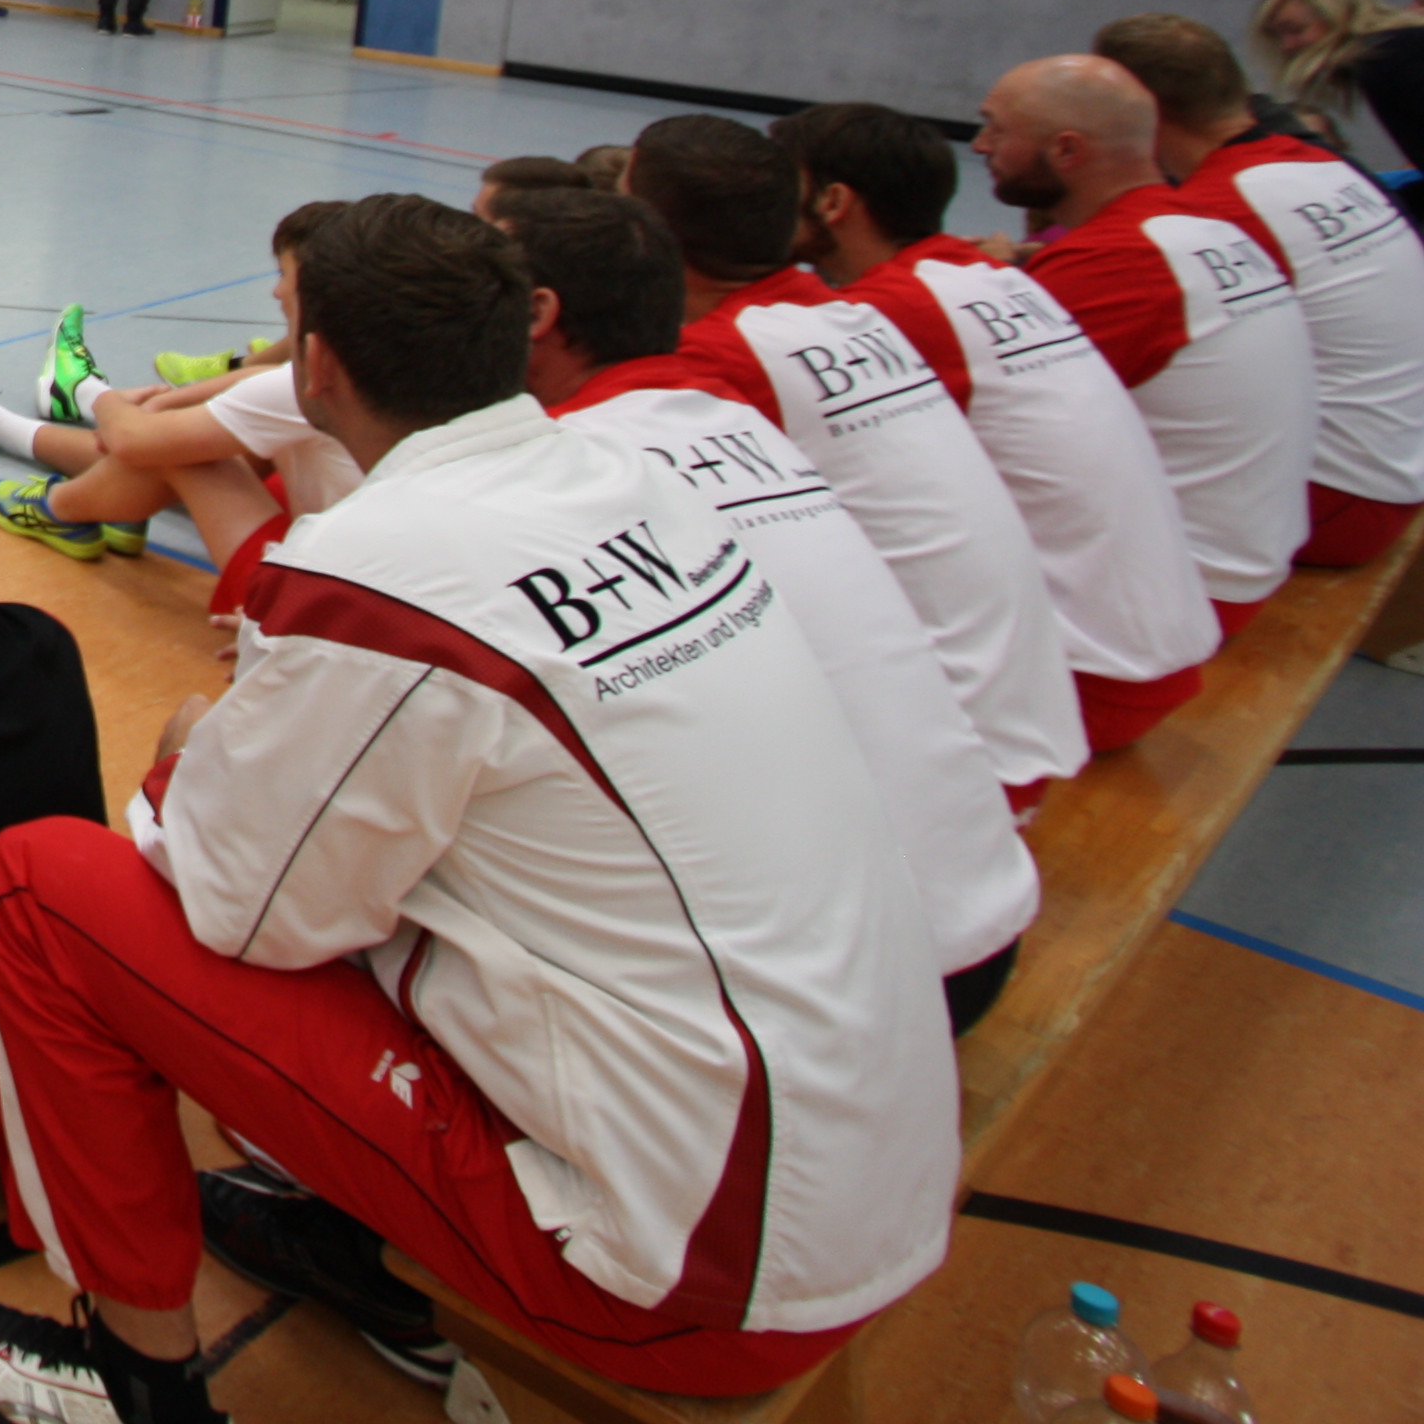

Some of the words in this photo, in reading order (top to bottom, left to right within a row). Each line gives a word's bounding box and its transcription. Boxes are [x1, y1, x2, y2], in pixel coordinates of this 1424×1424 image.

[788, 328, 908, 403] B+W
[506, 519, 689, 653] B+W
[595, 636, 709, 702] Architekten
[706, 613, 737, 649] und
